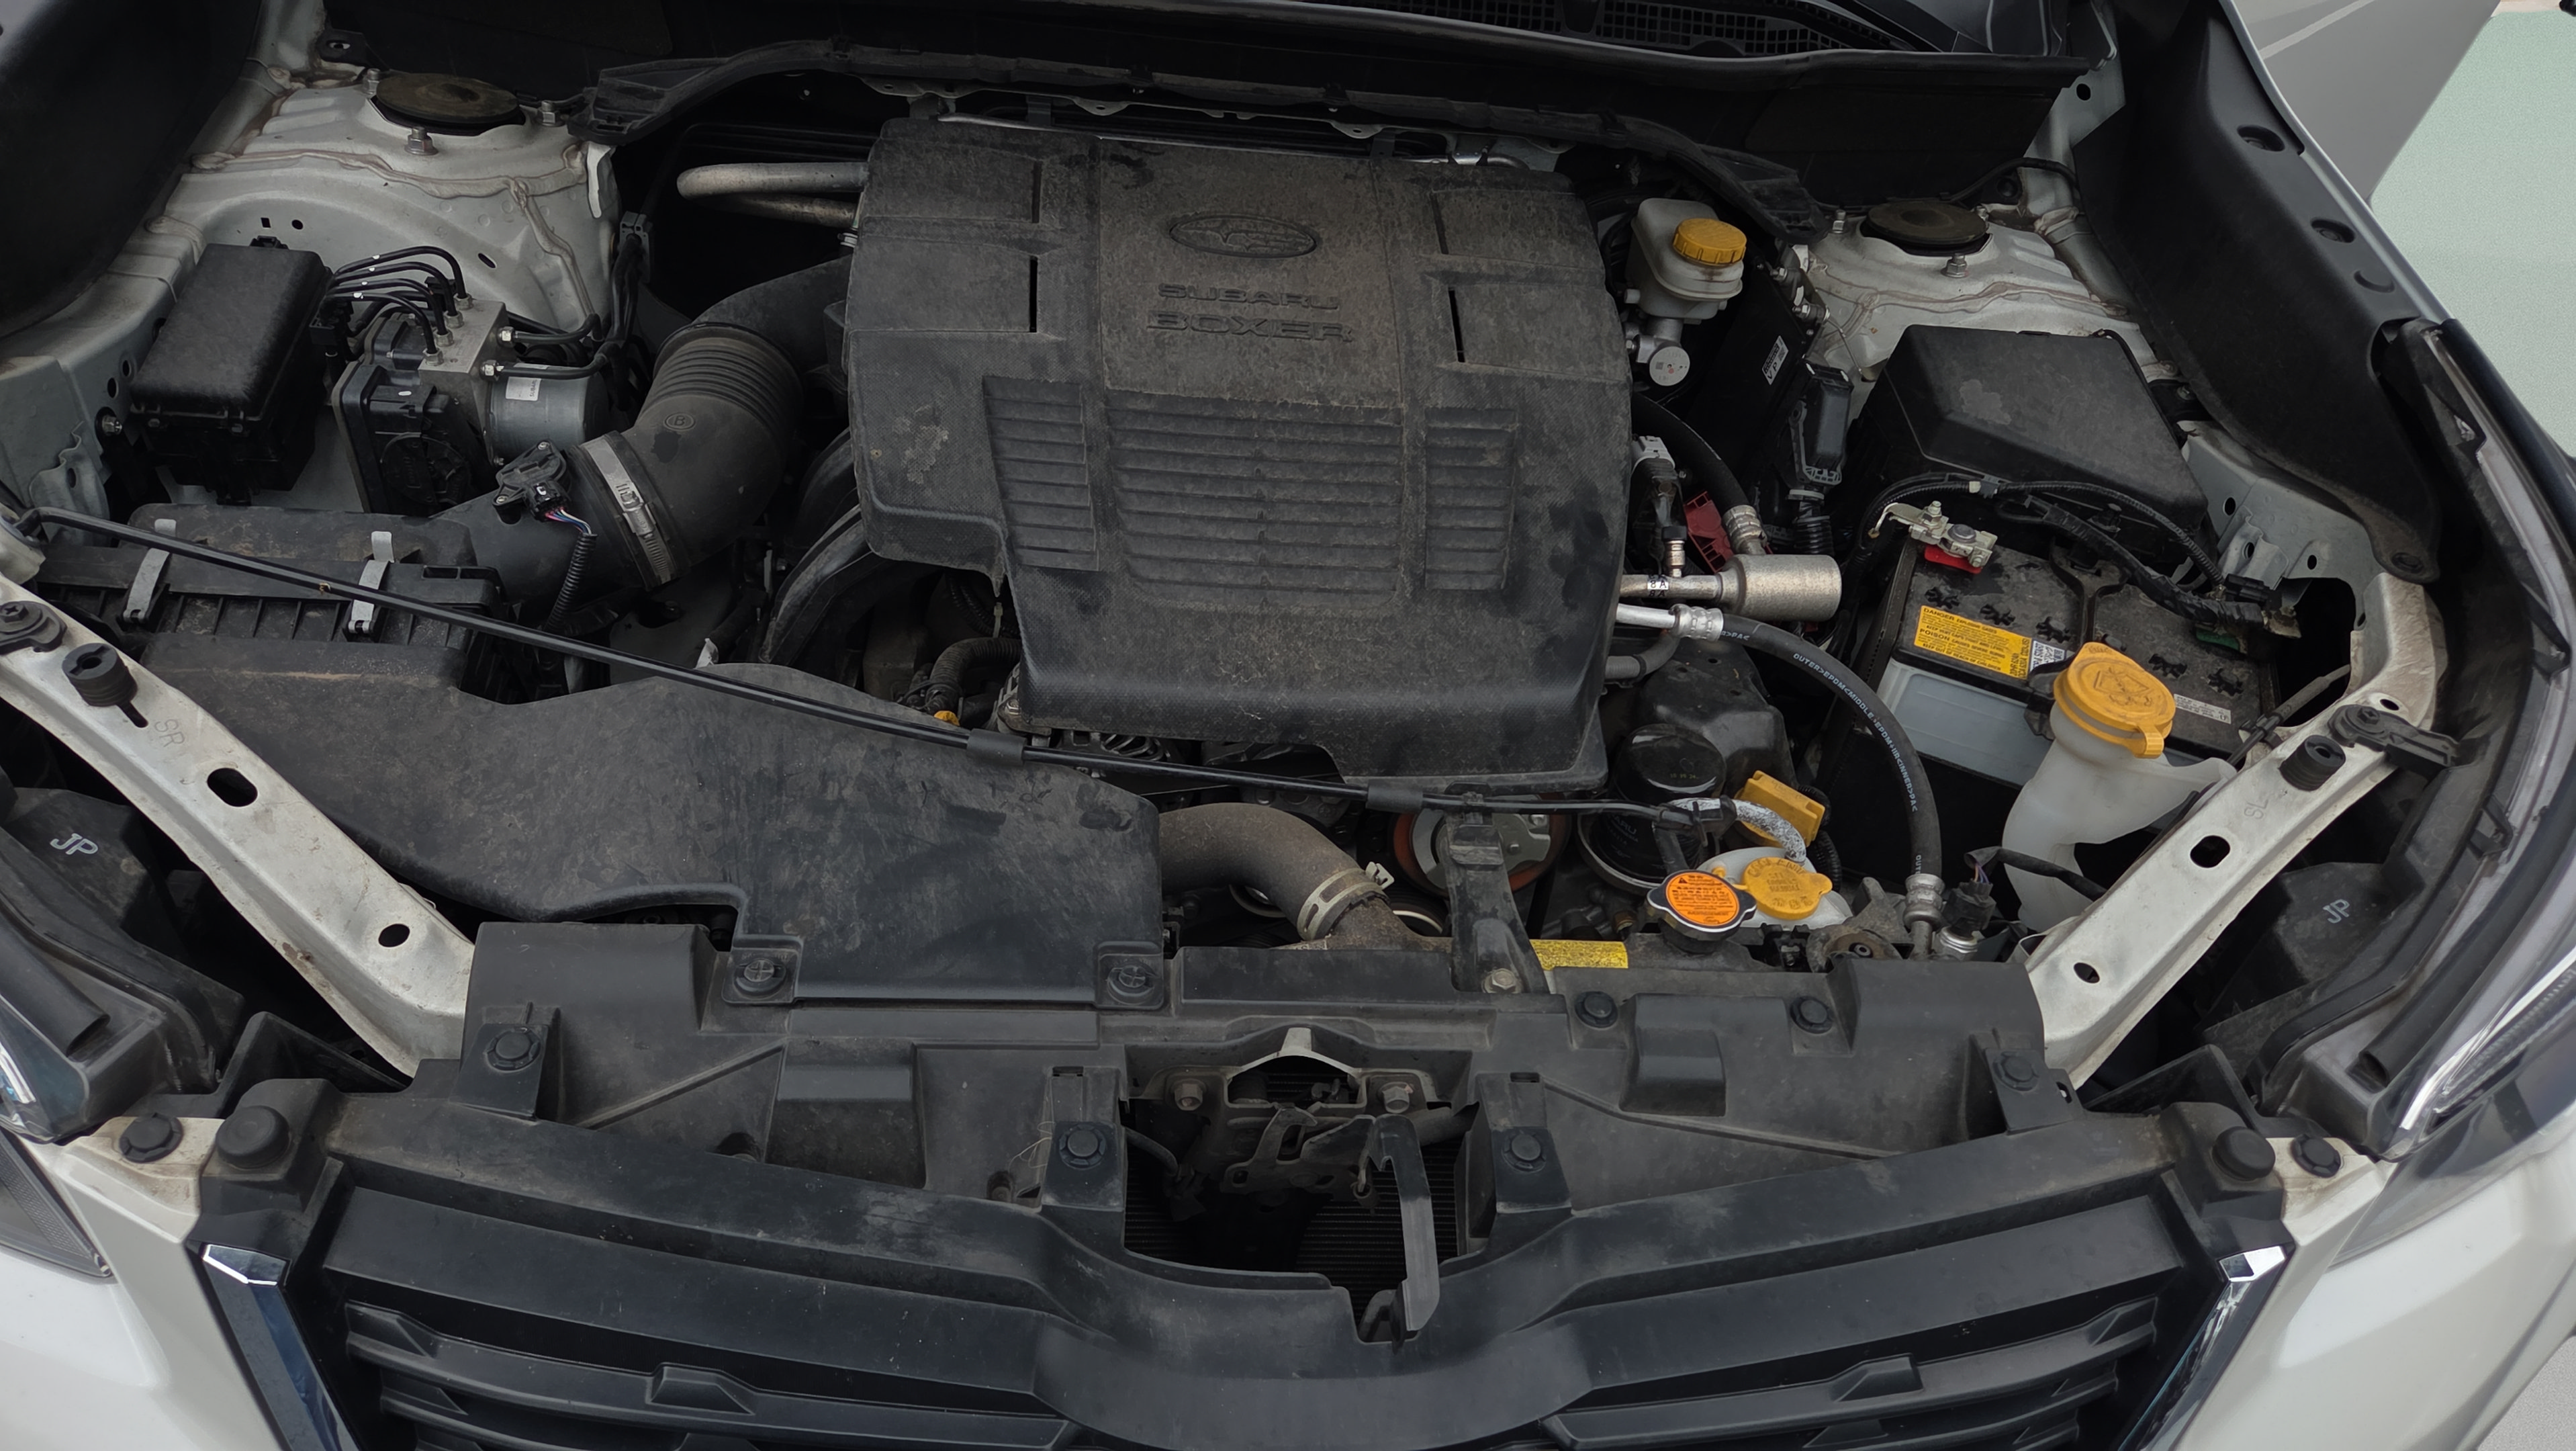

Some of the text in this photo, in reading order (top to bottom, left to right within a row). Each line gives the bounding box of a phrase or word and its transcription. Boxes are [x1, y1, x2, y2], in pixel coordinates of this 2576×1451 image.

[1158, 283, 1338, 310] SUBARU
[1146, 309, 1353, 343] BOXER
[1923, 607, 1955, 622] DANGER
[1919, 628, 1950, 642] POISON
[154, 718, 185, 748] SR
[49, 832, 99, 855] JP
[2322, 899, 2350, 924] JP
